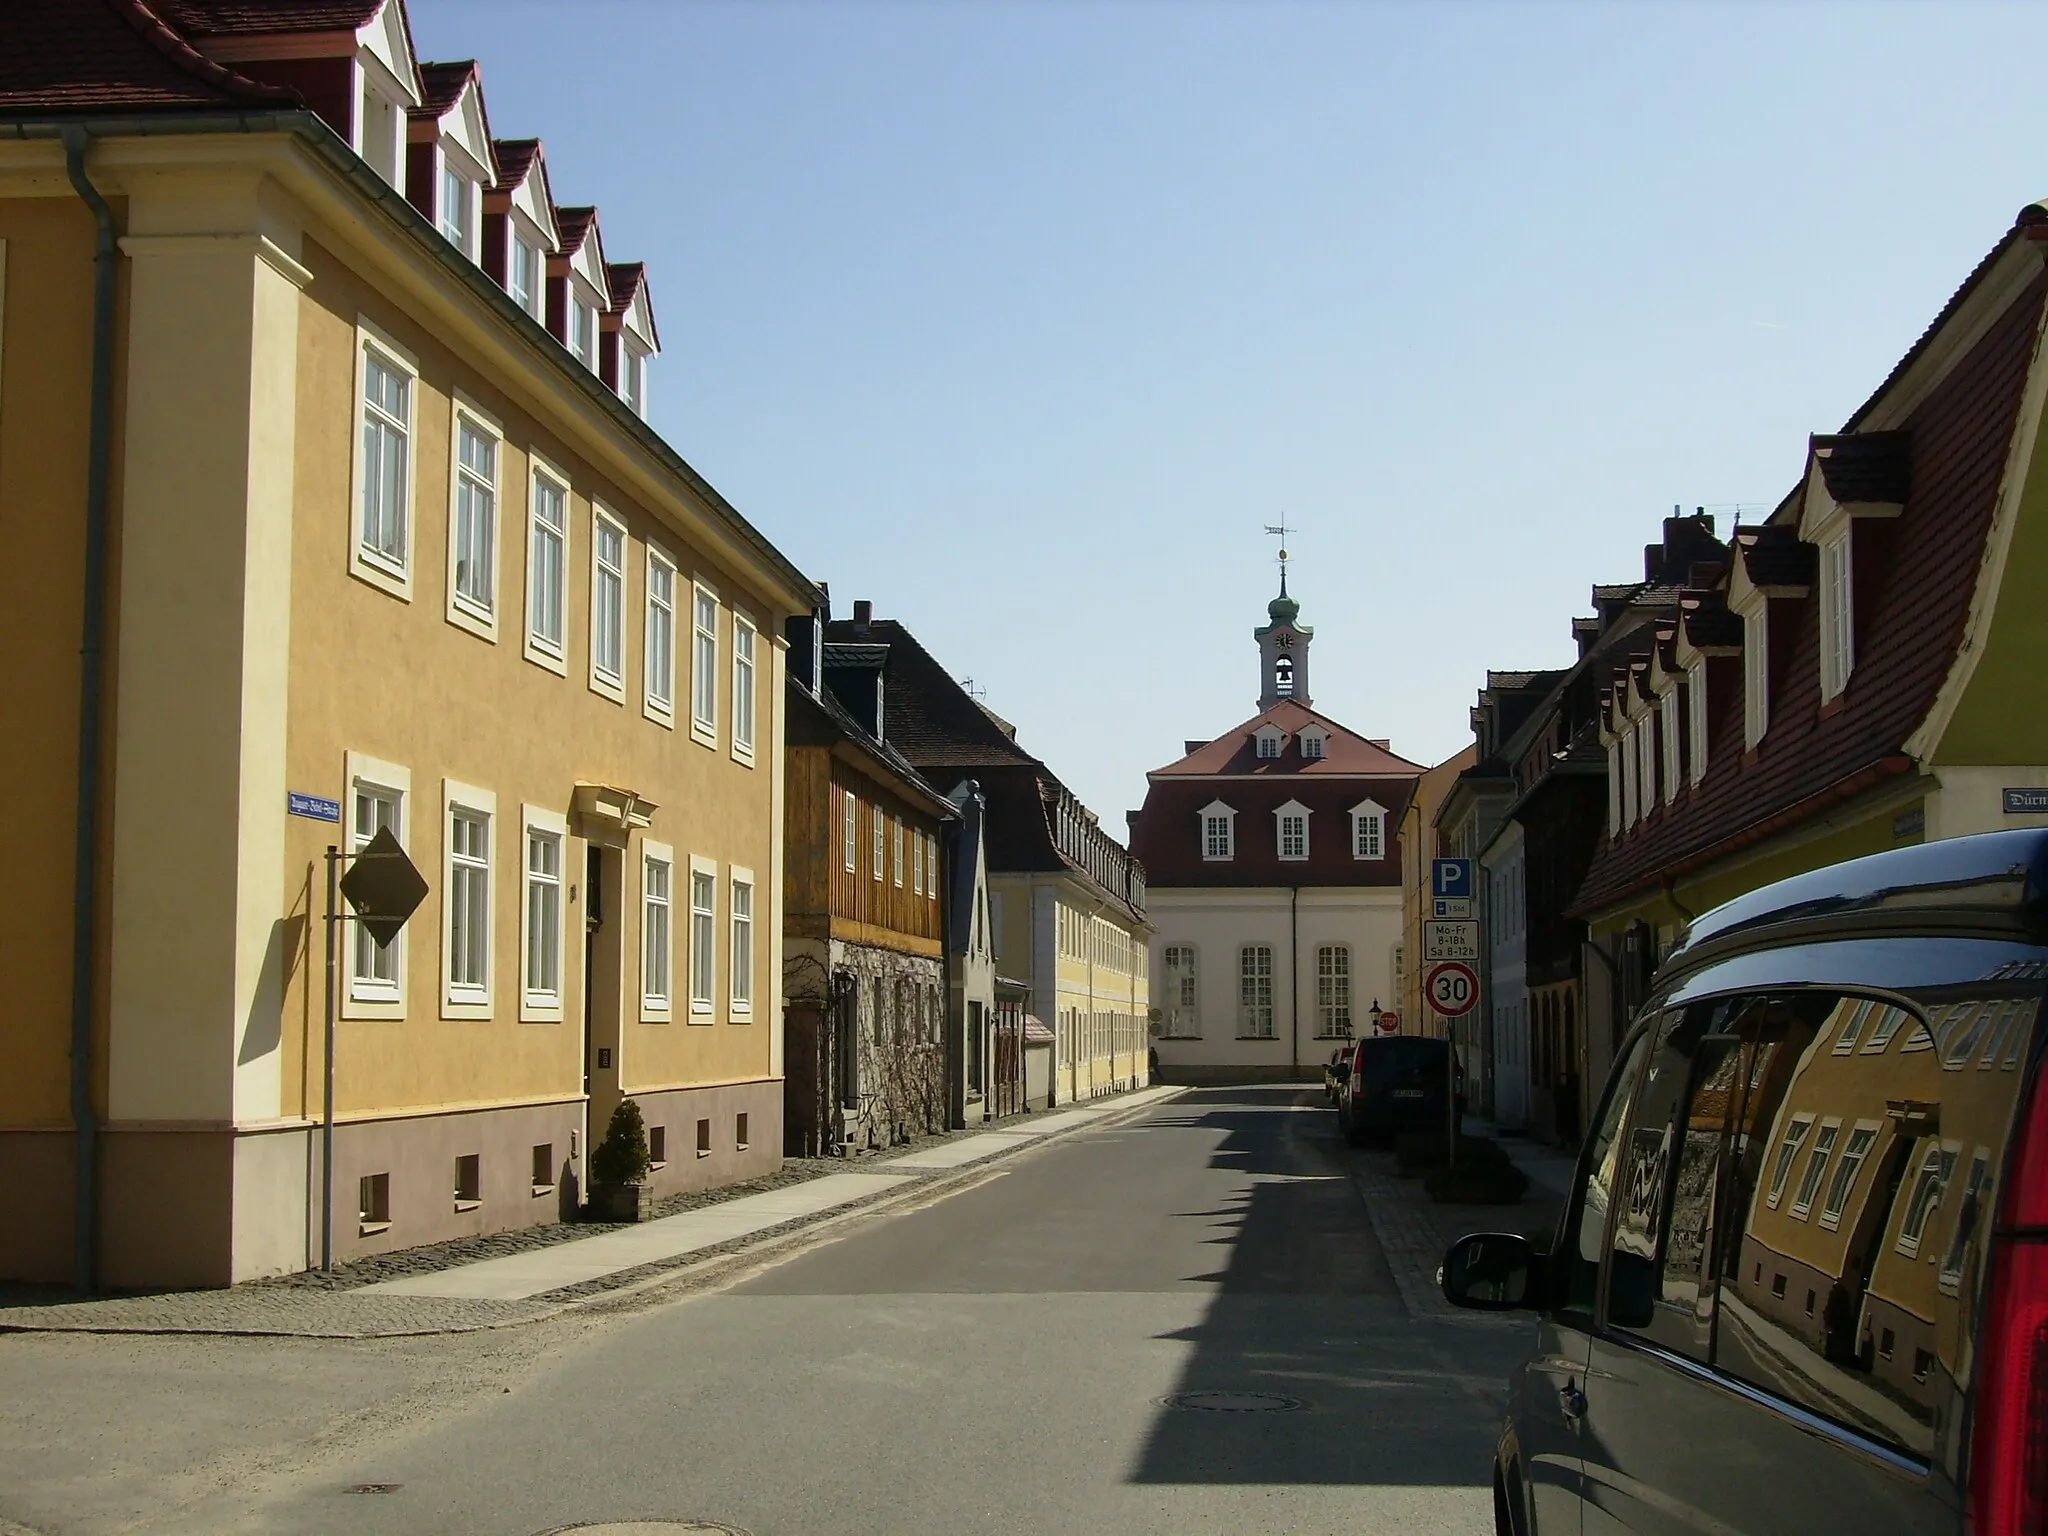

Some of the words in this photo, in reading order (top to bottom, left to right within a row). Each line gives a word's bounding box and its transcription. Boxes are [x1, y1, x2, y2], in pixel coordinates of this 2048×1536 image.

[1441, 863, 1462, 892] P
[1435, 925, 1466, 935] Mo-Fr
[1438, 936, 1466, 945] 8-18h
[1430, 947, 1443, 956] Sa
[1447, 947, 1474, 956] 8-12h
[1436, 977, 1468, 1002] 30
[1380, 1017, 1397, 1026] STOP
